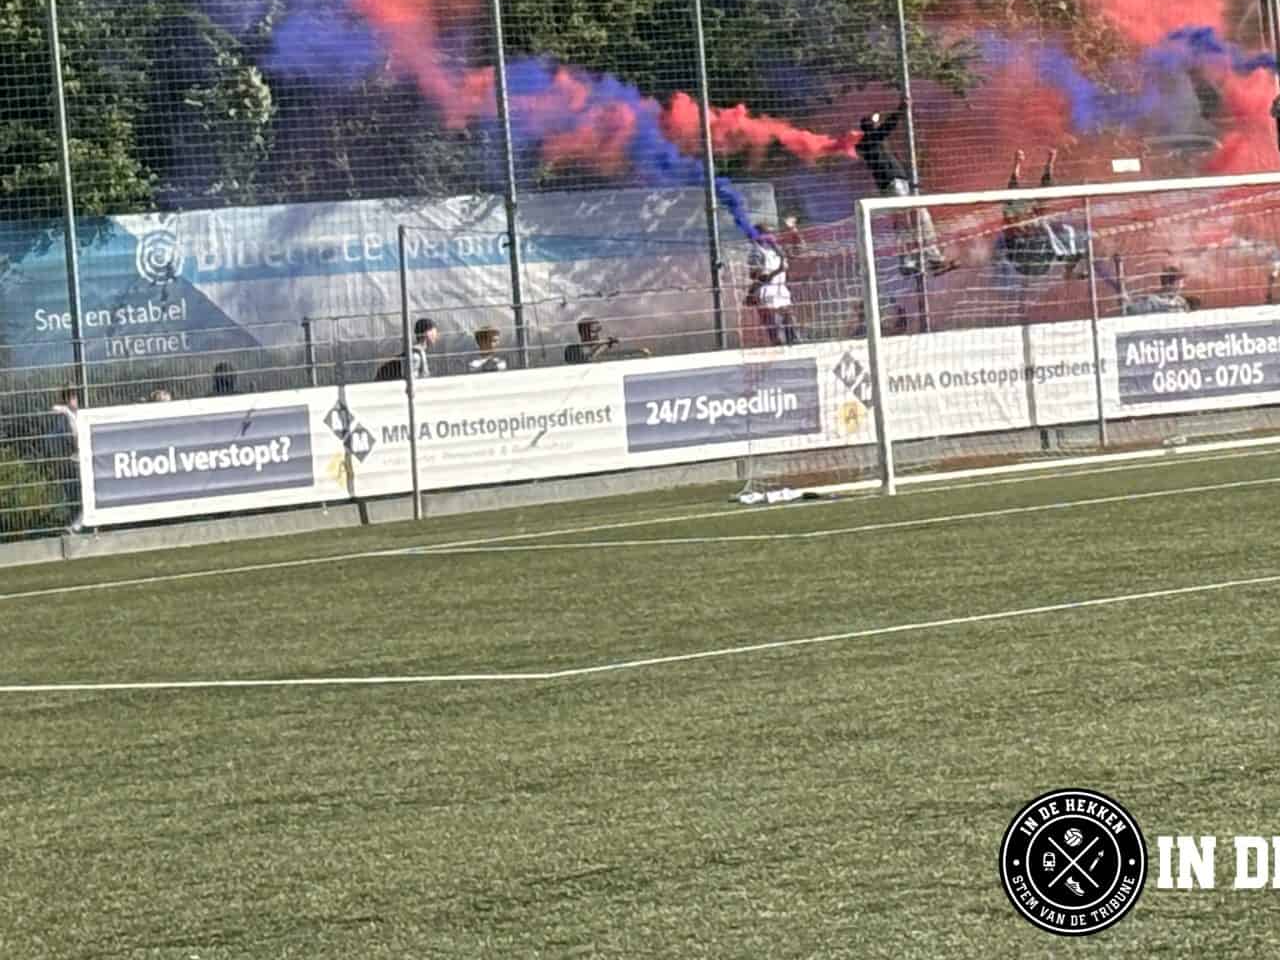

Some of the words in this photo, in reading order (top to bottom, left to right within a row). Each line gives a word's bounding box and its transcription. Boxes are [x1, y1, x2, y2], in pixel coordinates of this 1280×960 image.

[34, 308, 80, 331] Sne
[86, 309, 111, 327] en
[116, 298, 187, 325] stabiel
[104, 333, 191, 357] internet
[1126, 338, 1178, 368] Altijd
[888, 373, 936, 392] MMA
[1152, 368, 1201, 392] 0800
[1215, 363, 1264, 387] 0705
[436, 405, 612, 439] Ontstoppingsdienst
[646, 398, 691, 426] 24/7
[696, 388, 797, 424] Spoedlijn
[114, 446, 176, 479] Riool
[180, 436, 291, 472] verstopt?
